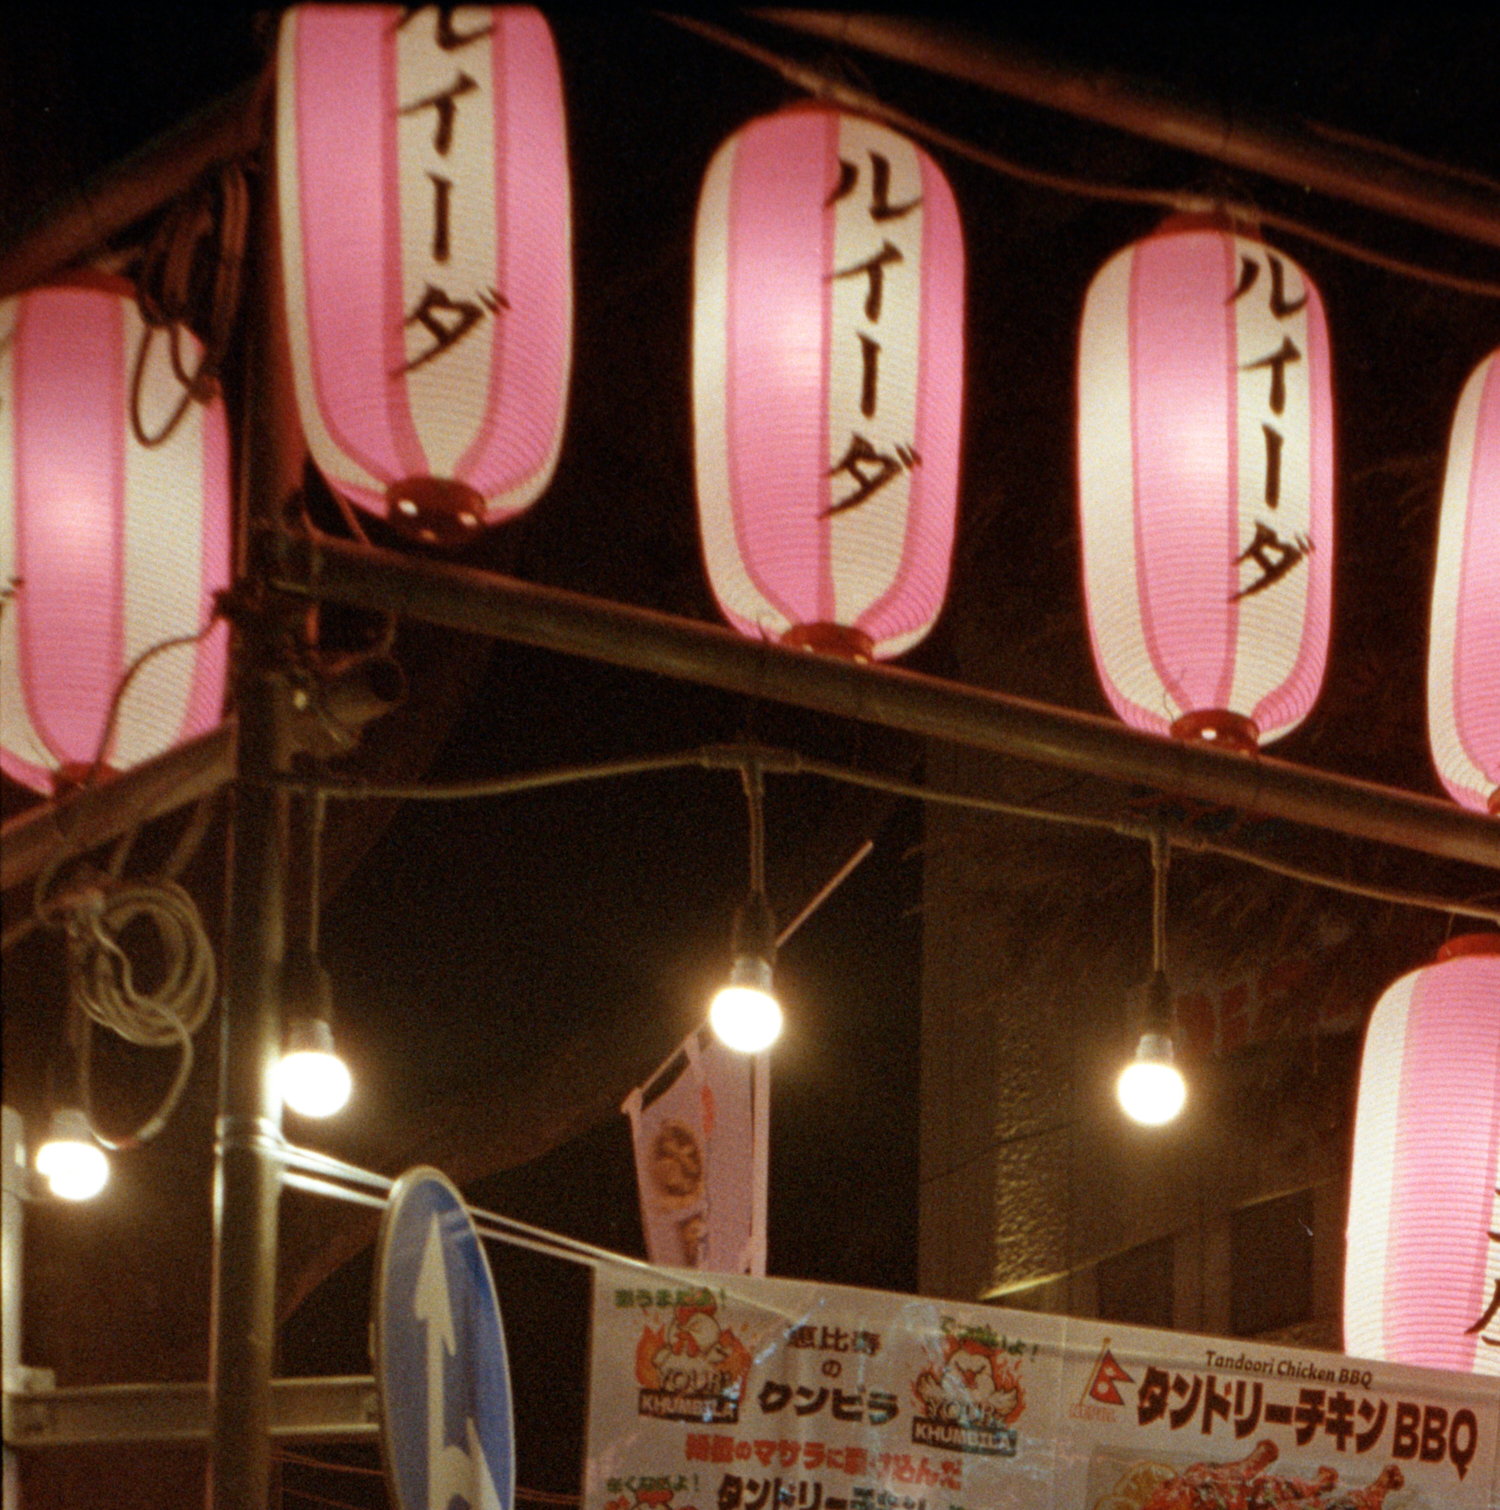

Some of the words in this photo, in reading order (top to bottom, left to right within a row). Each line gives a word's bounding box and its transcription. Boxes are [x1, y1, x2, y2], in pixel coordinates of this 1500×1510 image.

[817, 151, 924, 520] ルイーダ
[1224, 254, 1316, 604] ルイーダ
[788, 1325, 882, 1358] 恵比寿
[821, 1359, 842, 1379] の
[1204, 1349, 1274, 1375] Tandoori
[1277, 1359, 1335, 1384] Chicken
[1339, 1367, 1373, 1390] BBQ
[1137, 1366, 1388, 1455] タンドリーチキン
[1391, 1401, 1478, 1481] BBQ
